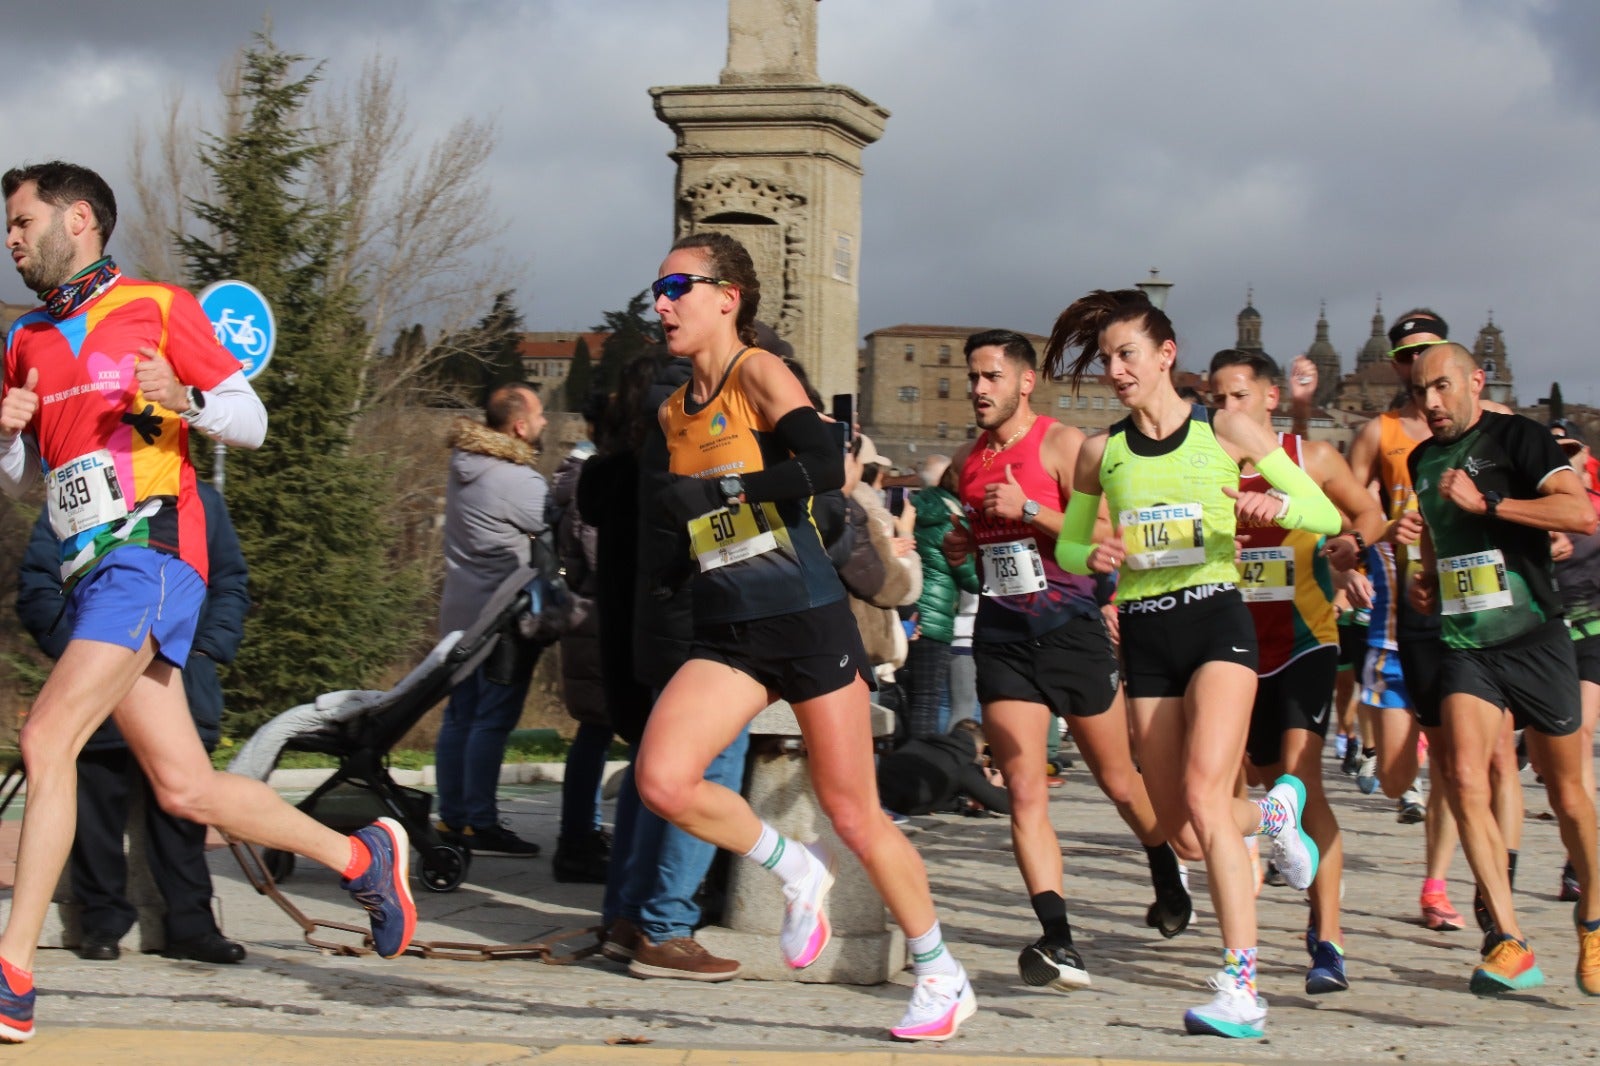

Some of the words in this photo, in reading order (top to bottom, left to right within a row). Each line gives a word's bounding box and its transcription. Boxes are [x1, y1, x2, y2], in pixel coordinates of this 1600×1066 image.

[98, 371, 120, 380] XXXIX
[43, 393, 55, 405] SAN
[55, 386, 80, 401] SILVESTRE
[81, 380, 120, 394] SALMANTINA
[57, 457, 103, 482] SETEL
[60, 476, 91, 512] 439
[1140, 508, 1194, 521] SETEL
[709, 511, 735, 542] 50
[1143, 523, 1169, 548] 114
[992, 543, 1029, 555] SETEL
[1240, 550, 1286, 560] SETEL
[992, 557, 1018, 578] 733
[1243, 562, 1264, 583] 42
[1450, 555, 1495, 569] SETEL
[1456, 571, 1474, 592] 61
[1128, 596, 1176, 614] PRO
